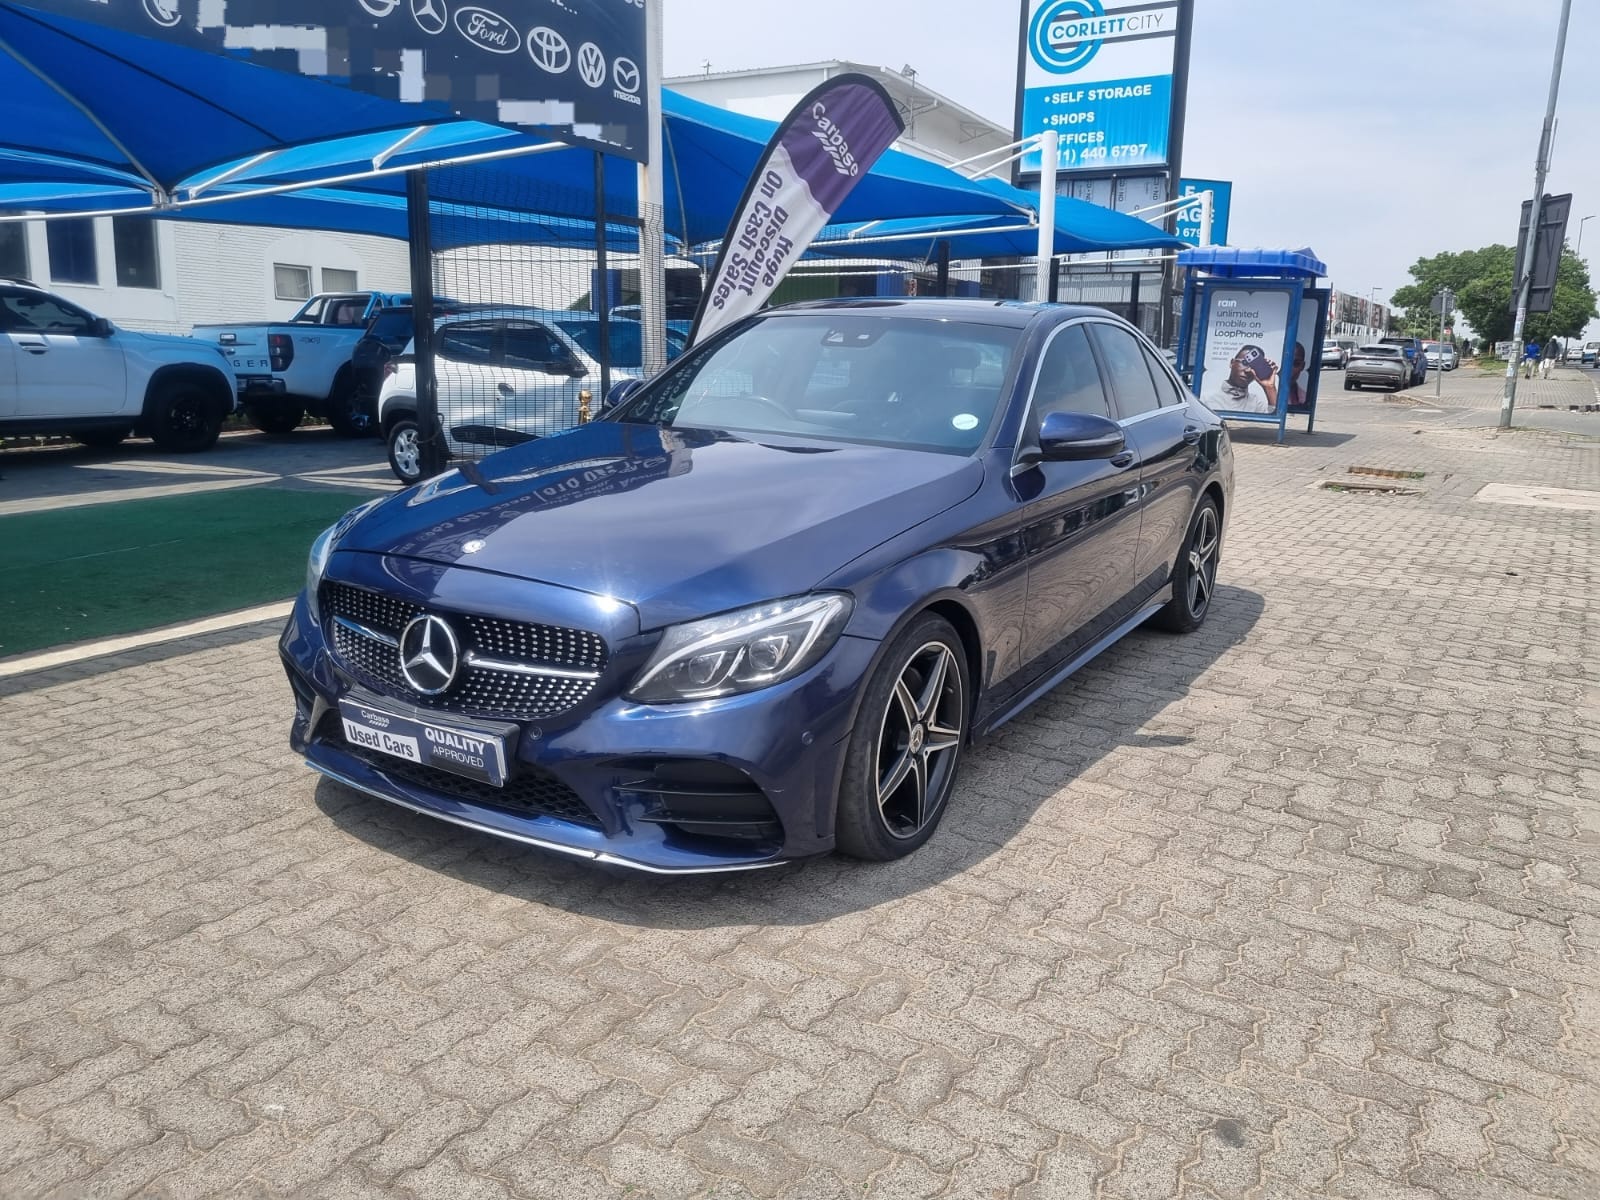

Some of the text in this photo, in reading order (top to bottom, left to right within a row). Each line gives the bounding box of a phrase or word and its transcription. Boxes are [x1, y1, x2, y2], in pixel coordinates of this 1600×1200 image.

[468, 13, 507, 46] Ford
[1052, 85, 1152, 104] SELF STORAGE
[1050, 111, 1095, 125] SHOPS
[812, 102, 859, 177] Carbase
[1057, 131, 1104, 145] FFICES
[1081, 146, 1107, 160] 440
[1111, 143, 1148, 157] 6797
[712, 170, 783, 310] On Cash Sales
[738, 205, 789, 297] Discount
[762, 235, 793, 288] Huge
[1217, 299, 1237, 308] rain
[1216, 310, 1259, 319] unlimited
[1215, 320, 1247, 328] mobile
[1214, 329, 1264, 339] LoopPhone
[233, 359, 269, 368] GER
[361, 710, 390, 724] Carbase
[349, 725, 415, 758] Used Cars
[424, 728, 486, 755] QUALITY
[432, 746, 485, 768] APPROVED
